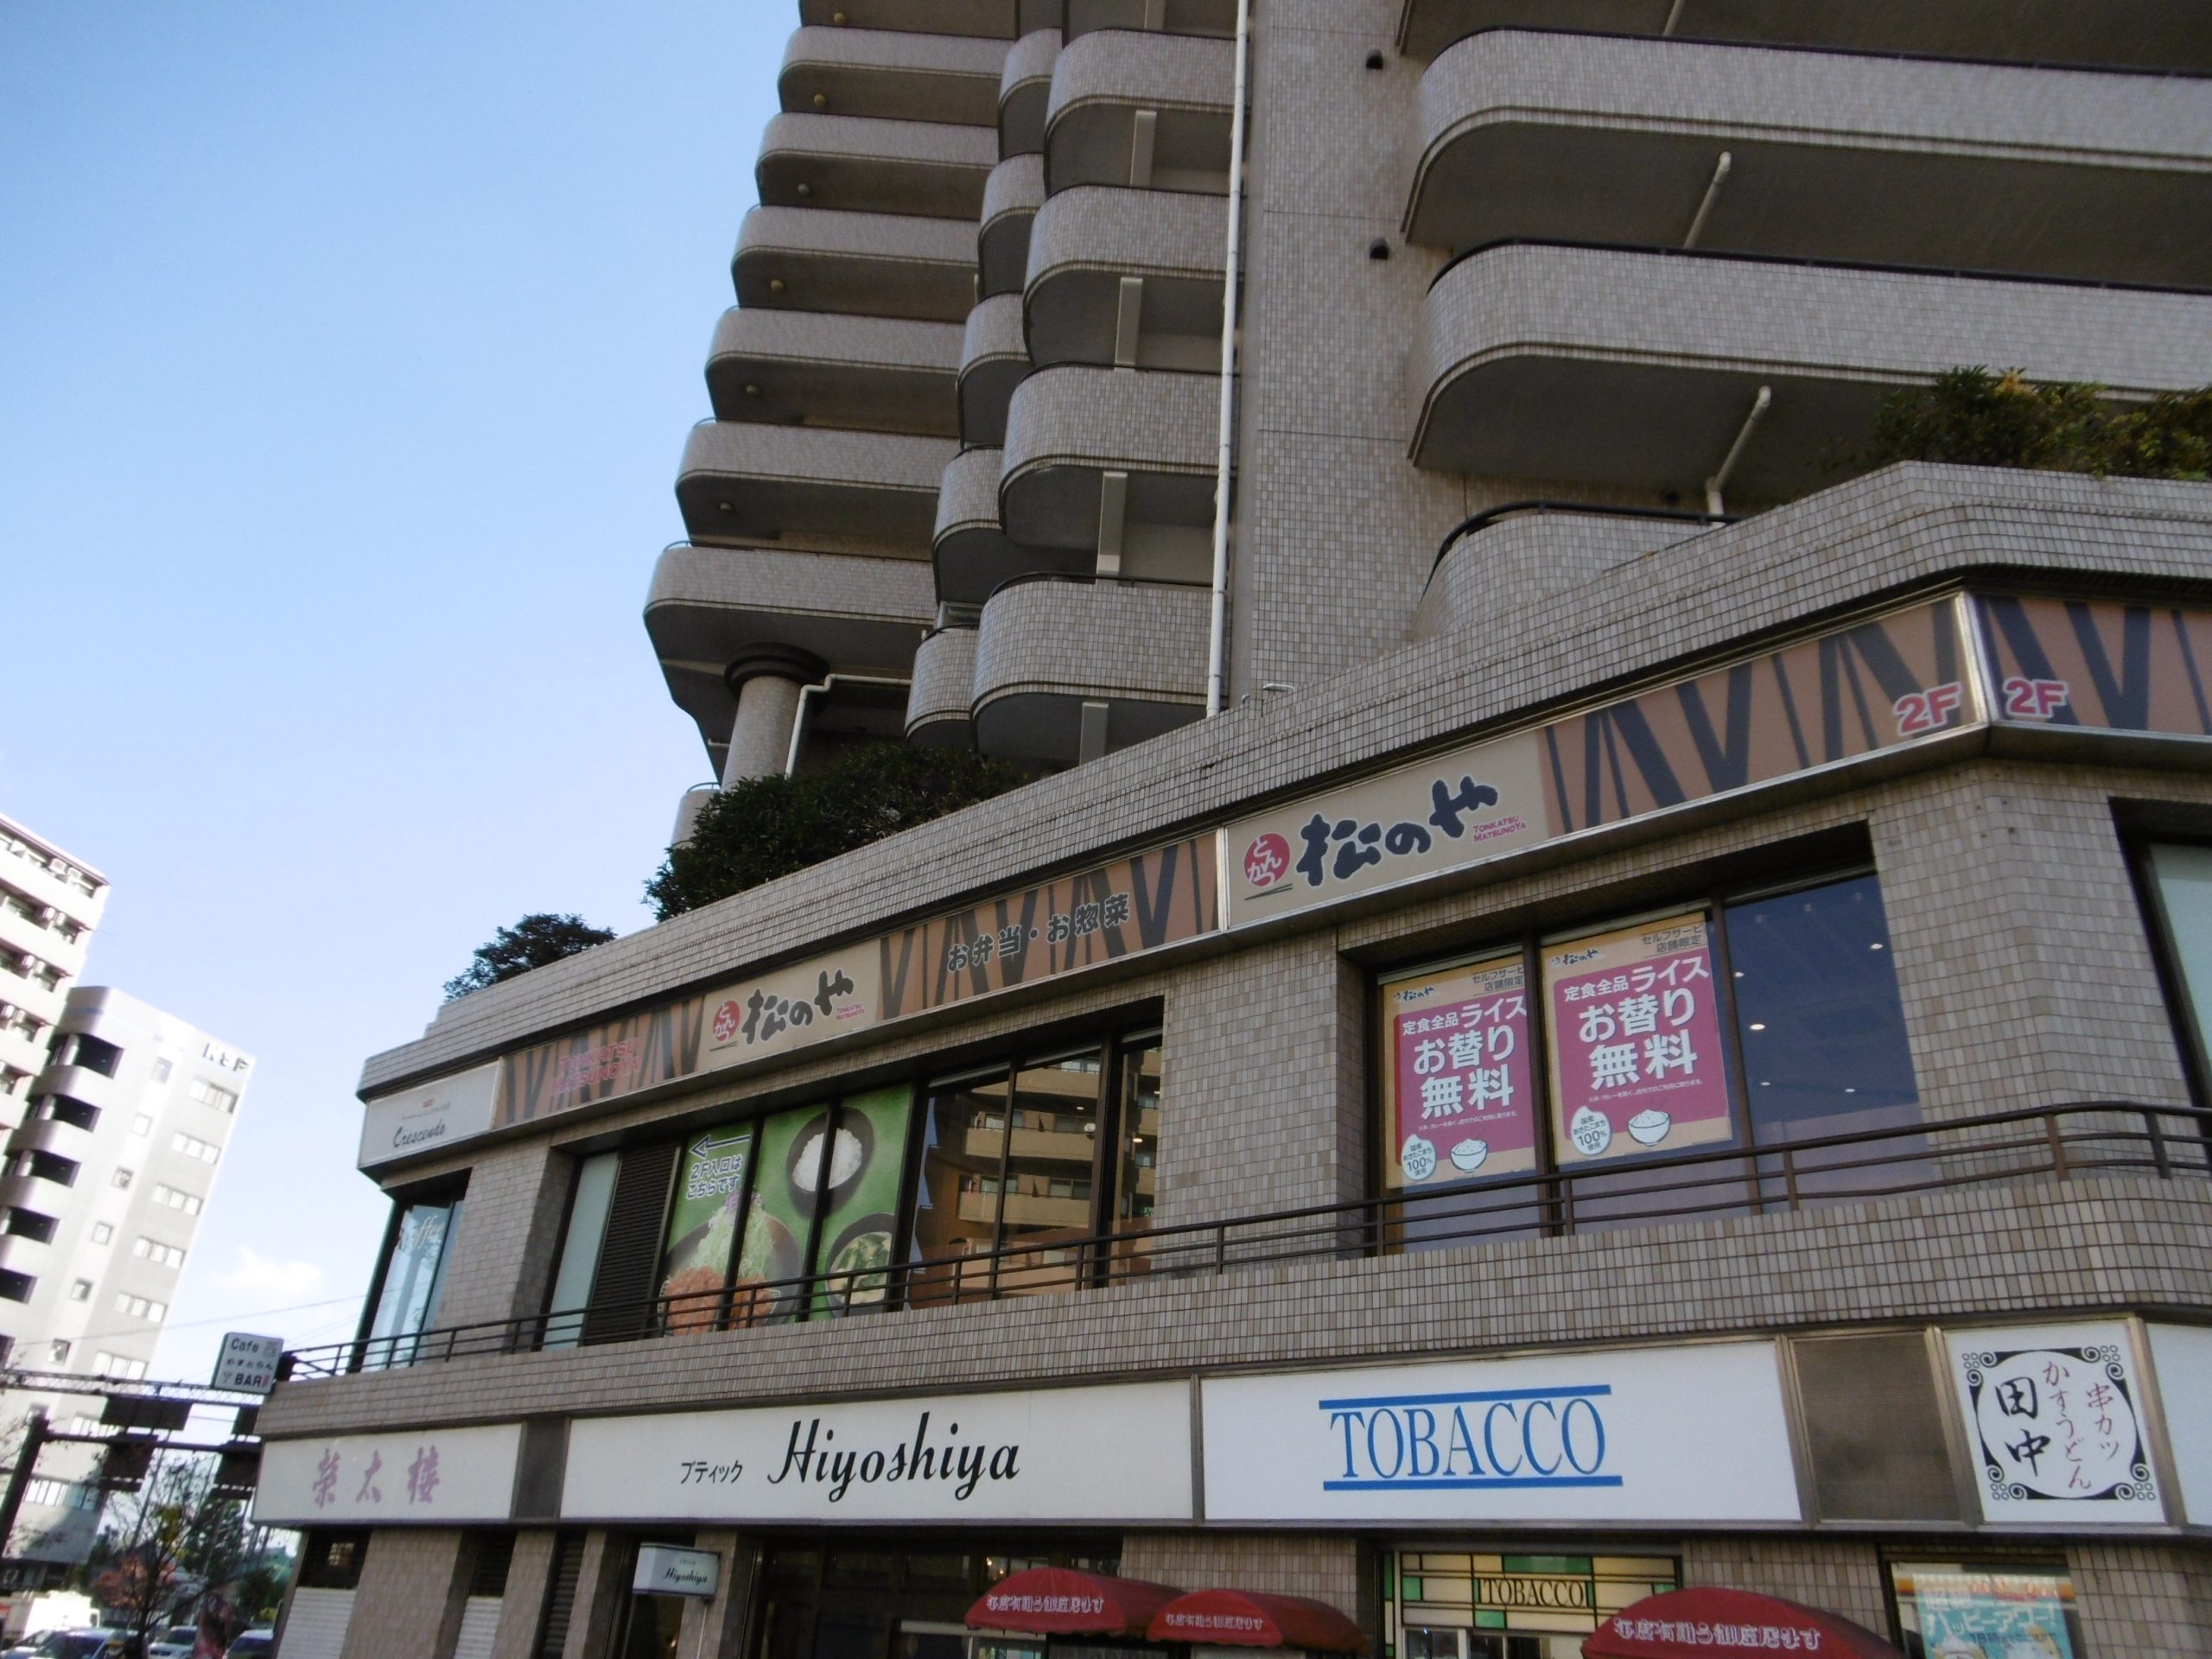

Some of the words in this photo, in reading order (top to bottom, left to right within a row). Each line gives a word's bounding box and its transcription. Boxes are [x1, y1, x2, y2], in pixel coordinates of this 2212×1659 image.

[1897, 683, 1961, 733] 2F
[2005, 679, 2065, 715] 2F
[1296, 776, 1498, 887] 松のや
[1473, 815, 1519, 833] TONKATSU
[1474, 821, 1527, 842] MATSUNOYA
[1248, 836, 1282, 884] とんかつ
[741, 969, 854, 1045] 松のや
[1580, 988, 1694, 1042] お替り
[1414, 1025, 1514, 1075] お替り
[1589, 1030, 1698, 1090] 無料
[1421, 1064, 1514, 1120] 無料
[1579, 1130, 1607, 1146] 100%
[687, 1174, 740, 1199] こちらです
[690, 1154, 742, 1180] 2F入口は
[231, 1338, 258, 1352] Cafe
[235, 1373, 262, 1387] BAR
[1330, 1398, 1605, 1479] TOBACCO
[1994, 1376, 2050, 1477] 田中
[2042, 1361, 2091, 1490] かすうどん
[2086, 1382, 2120, 1459] 串カツ
[680, 1460, 743, 1484] ブティック
[767, 1411, 1020, 1503] Hiyoshiya
[1482, 1579, 1584, 1607] TOBACCO
